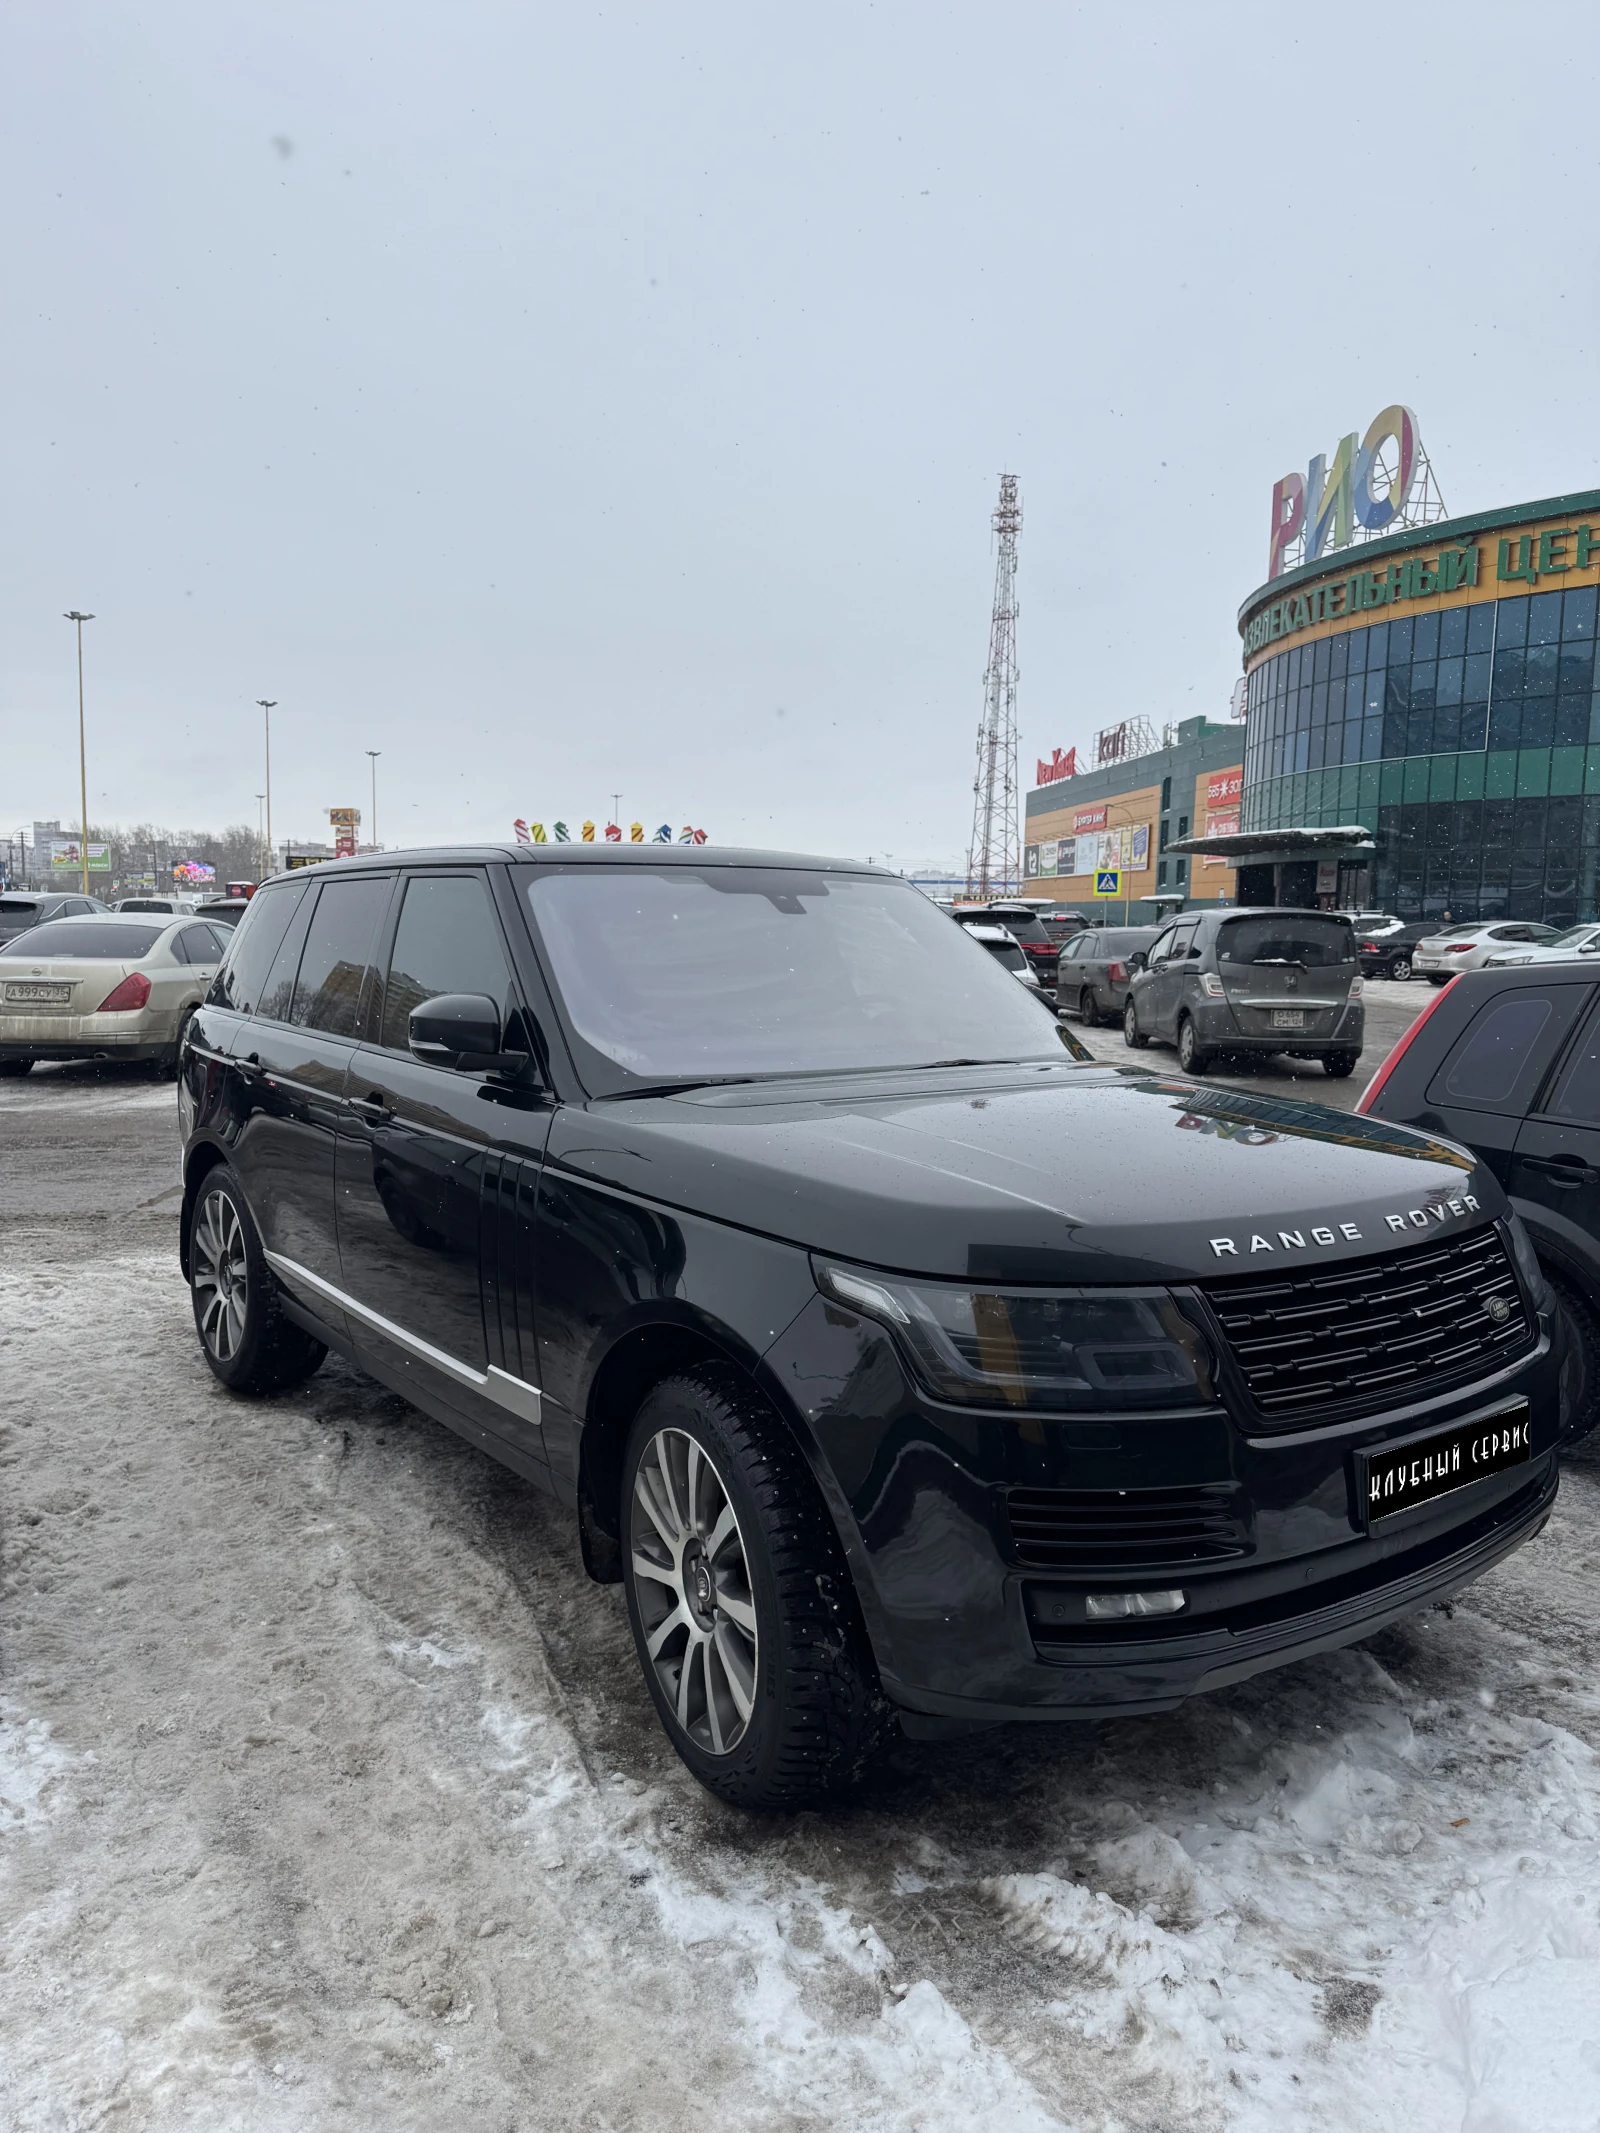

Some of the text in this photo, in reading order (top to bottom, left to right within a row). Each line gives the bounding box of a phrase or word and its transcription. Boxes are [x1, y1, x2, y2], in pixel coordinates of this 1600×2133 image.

[1269, 404, 1420, 581] РИО
[1208, 1195, 1482, 1257] RANGE ROVER
